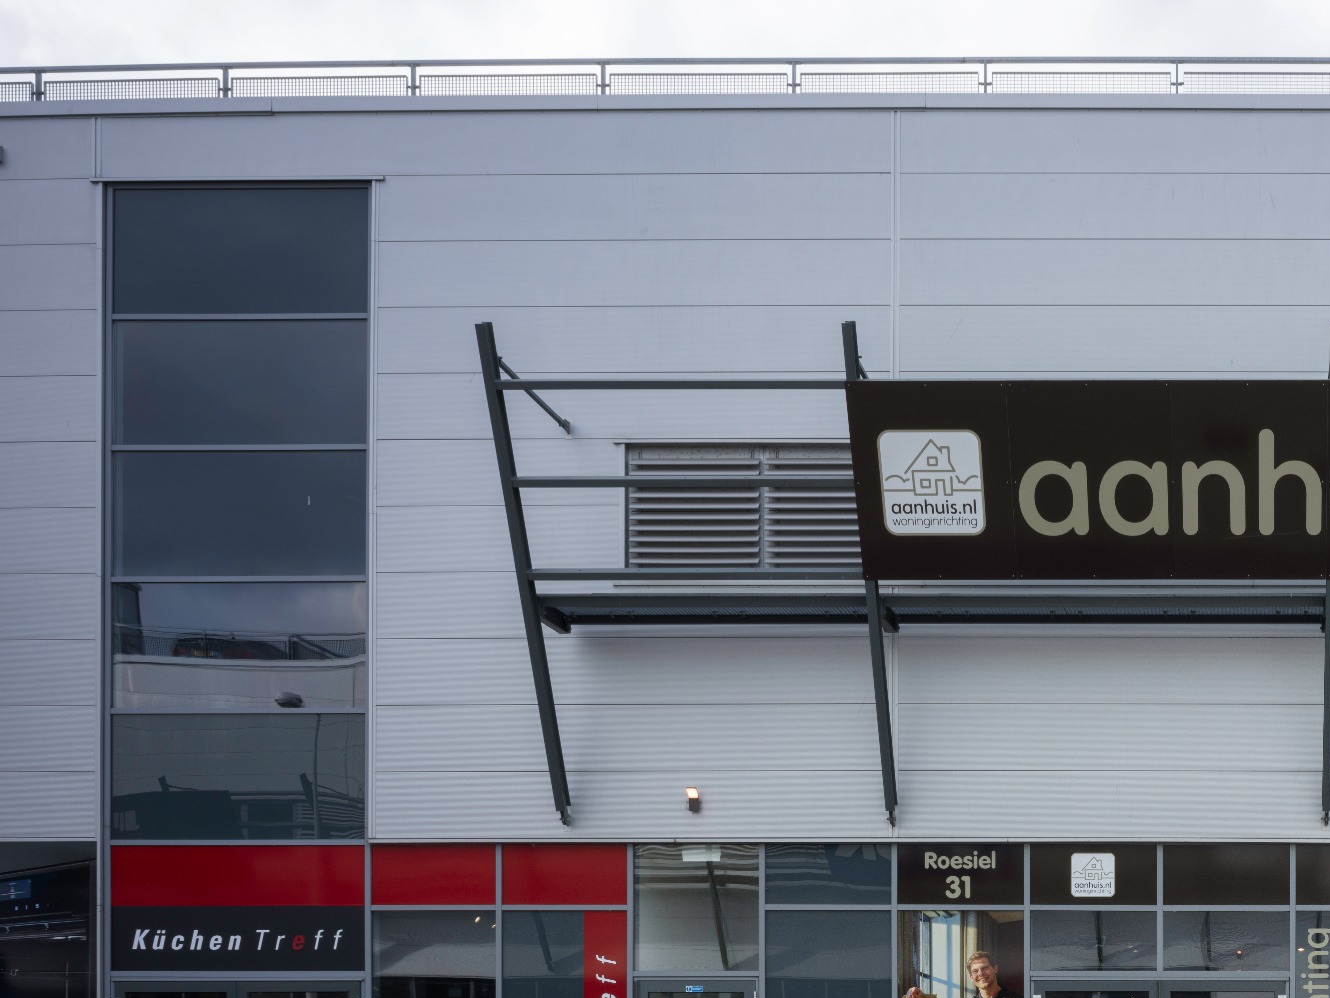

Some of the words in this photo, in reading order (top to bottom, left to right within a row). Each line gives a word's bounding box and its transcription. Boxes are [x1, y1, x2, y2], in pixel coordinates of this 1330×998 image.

[891, 498, 977, 515] aanhuis.nl
[891, 516, 978, 529] woninginrichting
[924, 850, 996, 870] Roesiel
[945, 875, 971, 899] 31
[131, 928, 242, 951] Küchen
[255, 929, 344, 951] Treff
